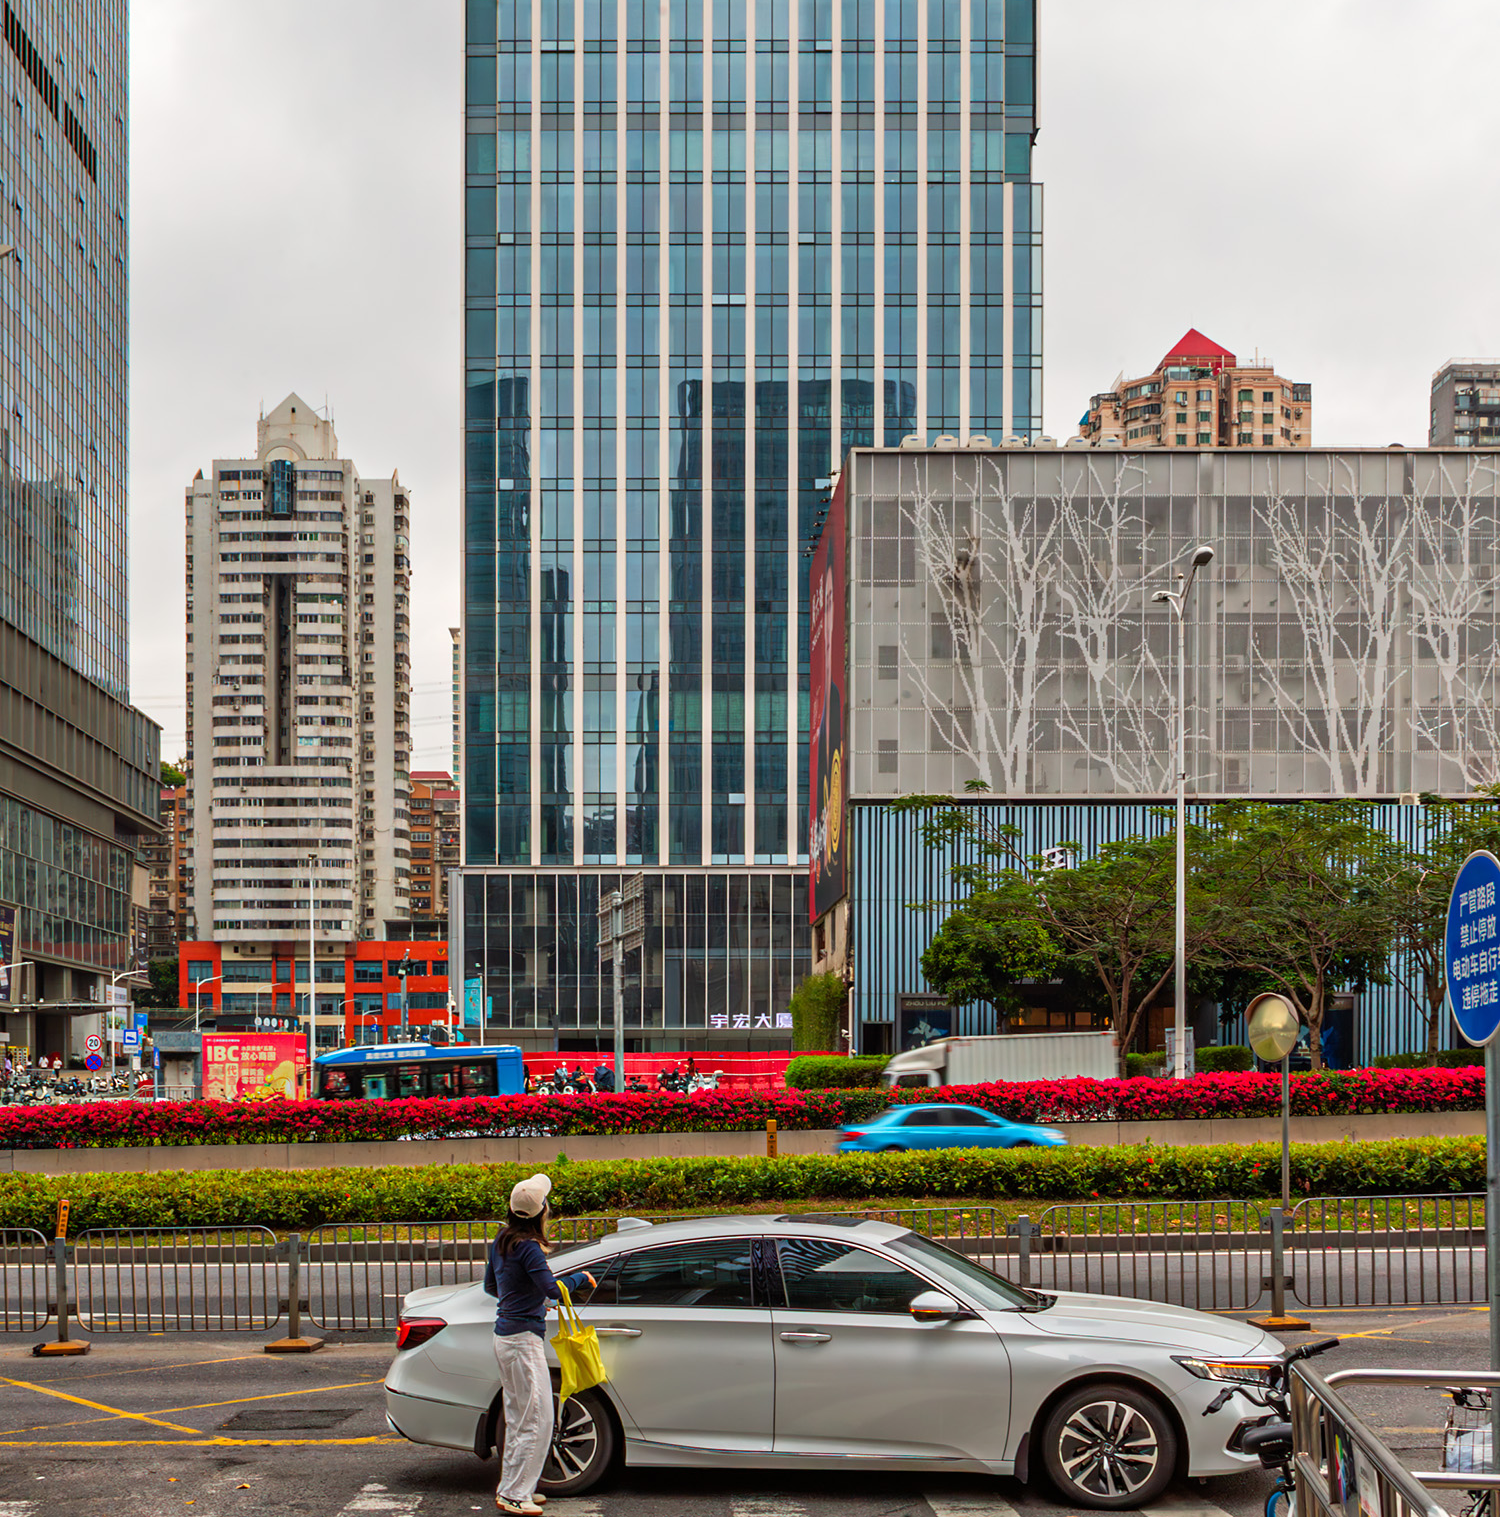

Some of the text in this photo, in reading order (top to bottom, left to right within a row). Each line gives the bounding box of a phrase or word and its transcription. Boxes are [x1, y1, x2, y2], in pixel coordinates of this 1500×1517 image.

[1459, 882, 1496, 917] 严管路段
[1460, 914, 1497, 949] 禁止停放
[1462, 978, 1498, 1010] 违停拖走
[88, 1038, 99, 1048] 20
[207, 1045, 240, 1061] IBC
